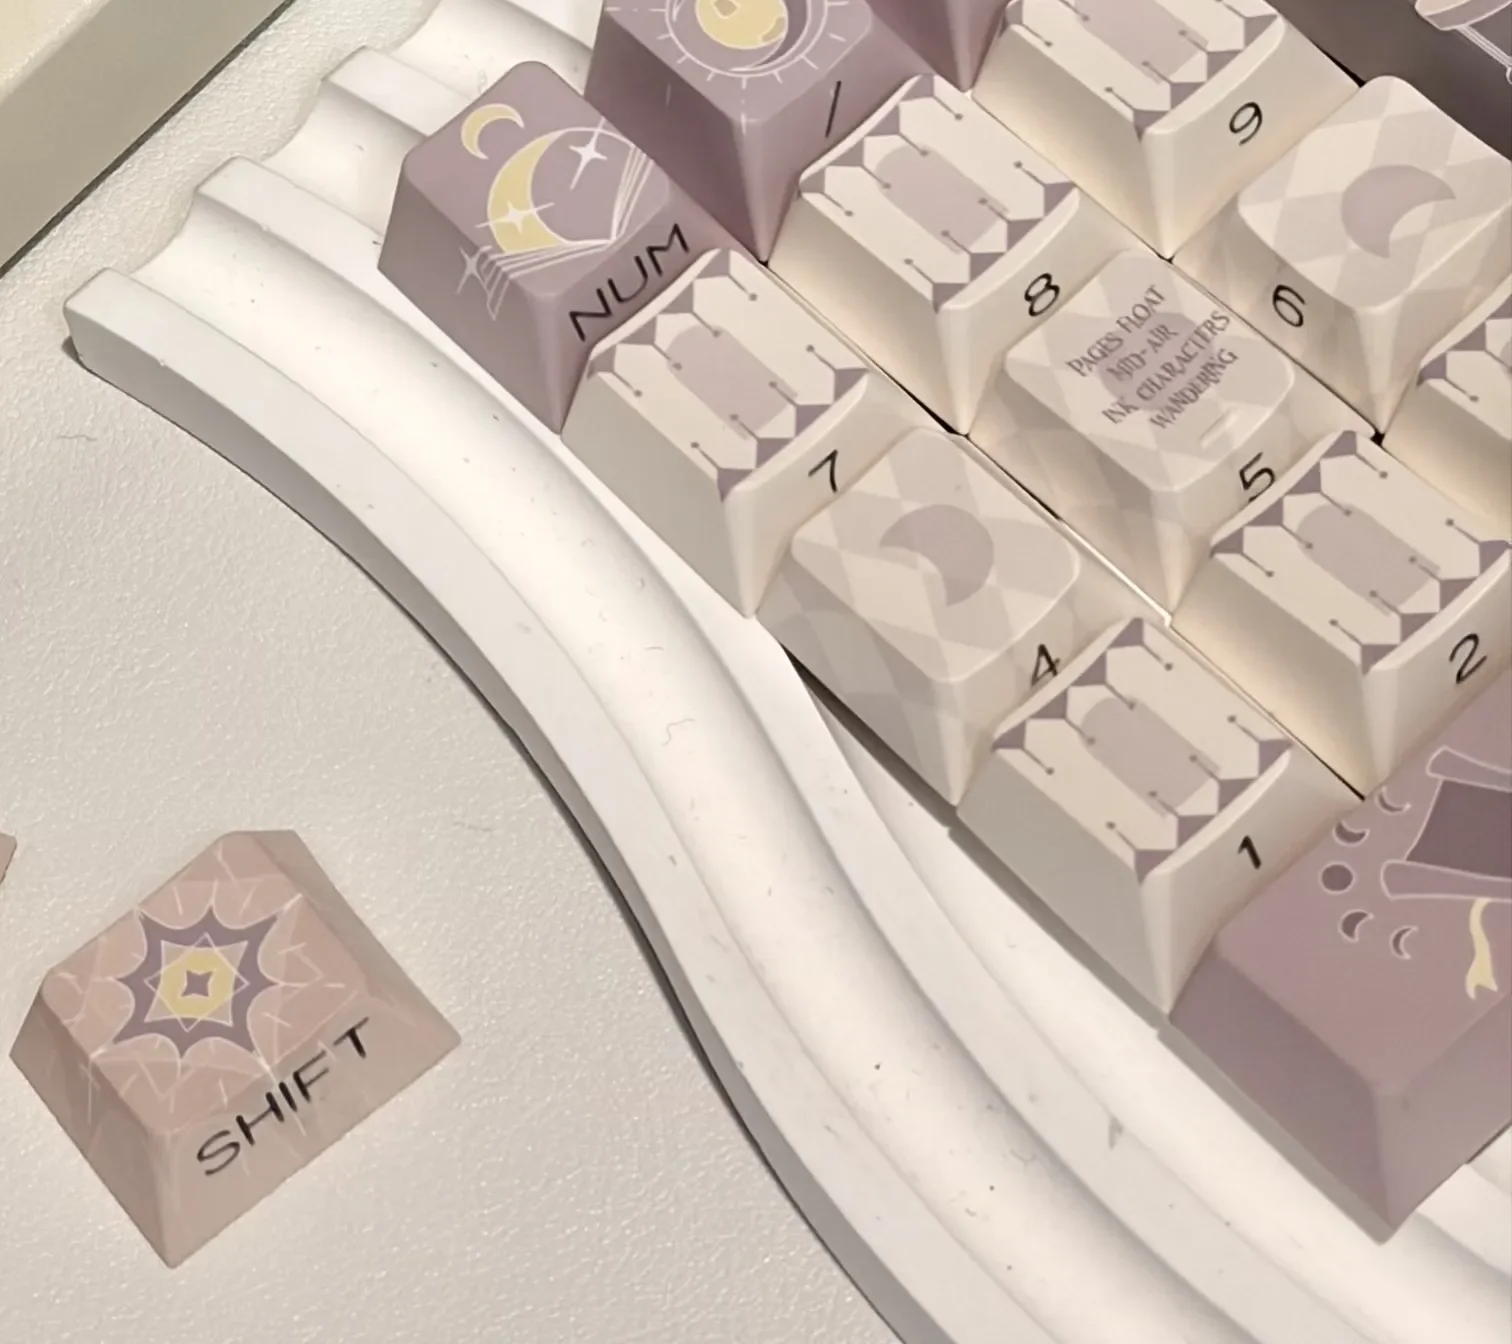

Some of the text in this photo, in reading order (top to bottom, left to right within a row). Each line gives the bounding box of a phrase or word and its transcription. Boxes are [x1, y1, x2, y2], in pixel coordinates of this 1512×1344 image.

[1228, 101, 1265, 146] 9
[569, 223, 689, 343] NUM
[1023, 272, 1061, 318] 8
[1271, 283, 1306, 329] 6
[1066, 284, 1167, 377] PAGES FLOAT
[1106, 323, 1181, 381] MID-AIR
[1136, 310, 1231, 401] CHARACTERS
[808, 449, 839, 494] 7
[1239, 450, 1276, 503] 5
[1029, 643, 1061, 689] 4
[1448, 632, 1488, 684] 2
[1236, 835, 1264, 870] 1
[196, 1016, 370, 1176] SHIFT
